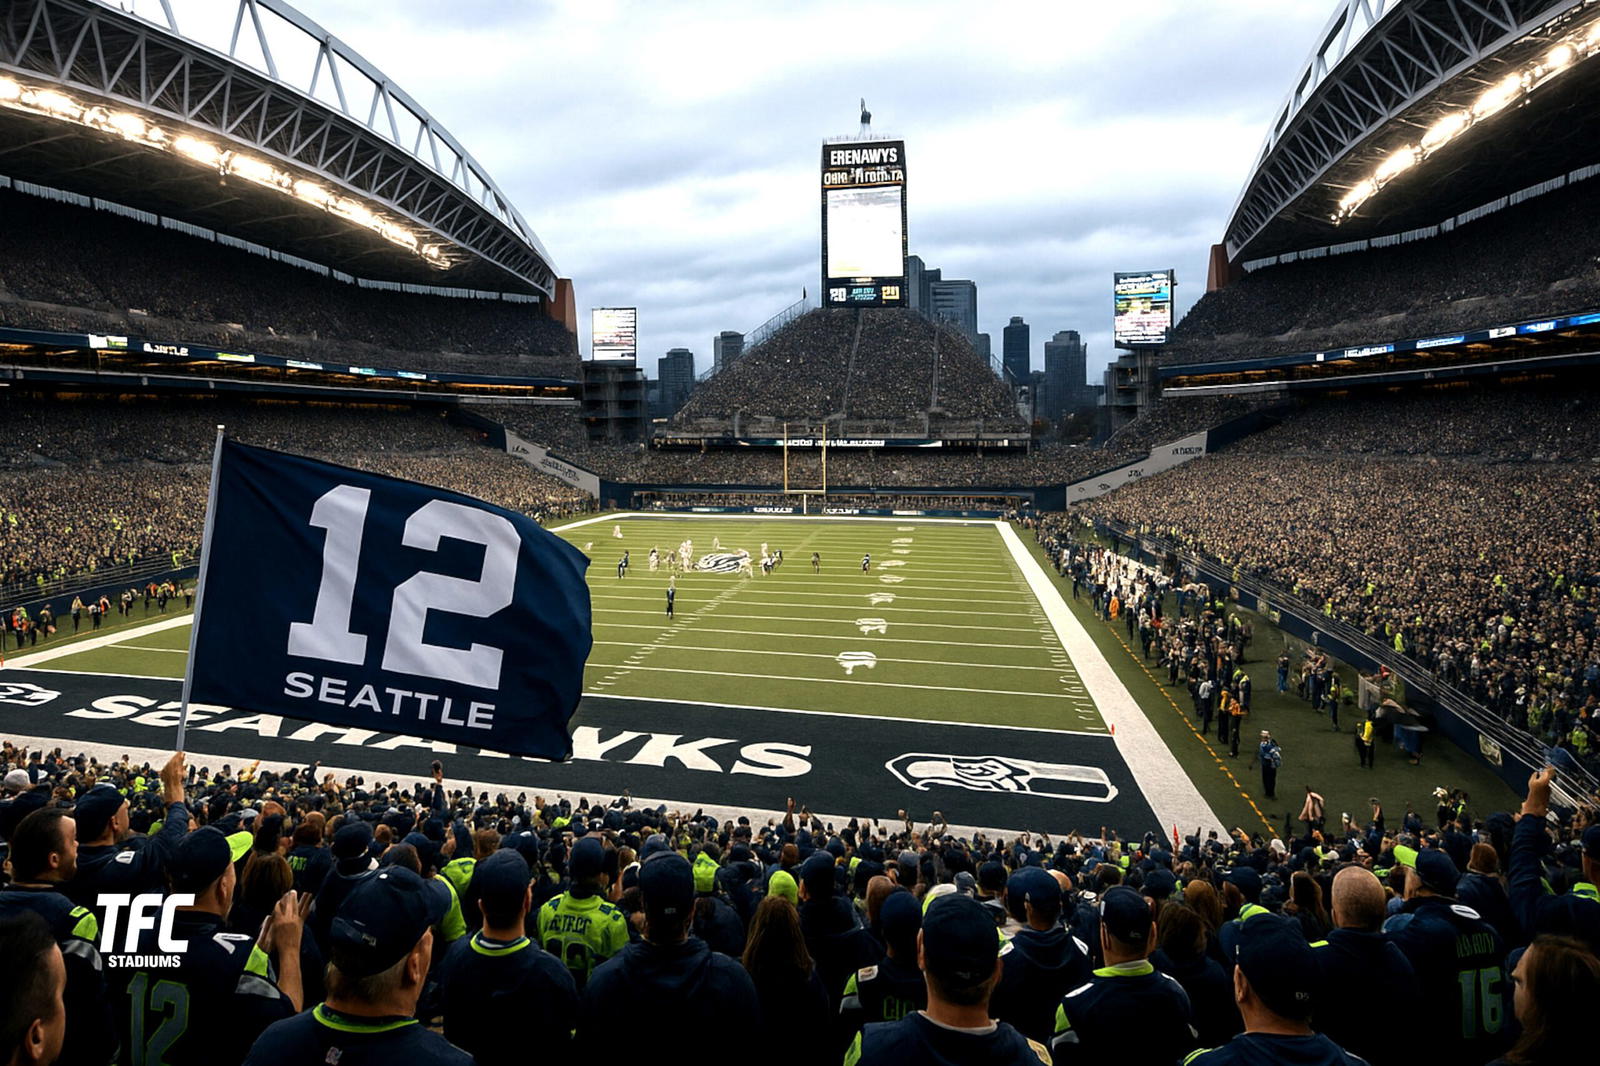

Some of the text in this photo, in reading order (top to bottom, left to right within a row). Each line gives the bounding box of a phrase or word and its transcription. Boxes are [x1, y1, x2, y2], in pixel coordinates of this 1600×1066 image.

[830, 147, 898, 166] ERENAWYS
[287, 484, 522, 690] 12
[283, 671, 496, 730] SEATTLE
[126, 971, 190, 1066] 12
[1457, 965, 1503, 1039] 16
